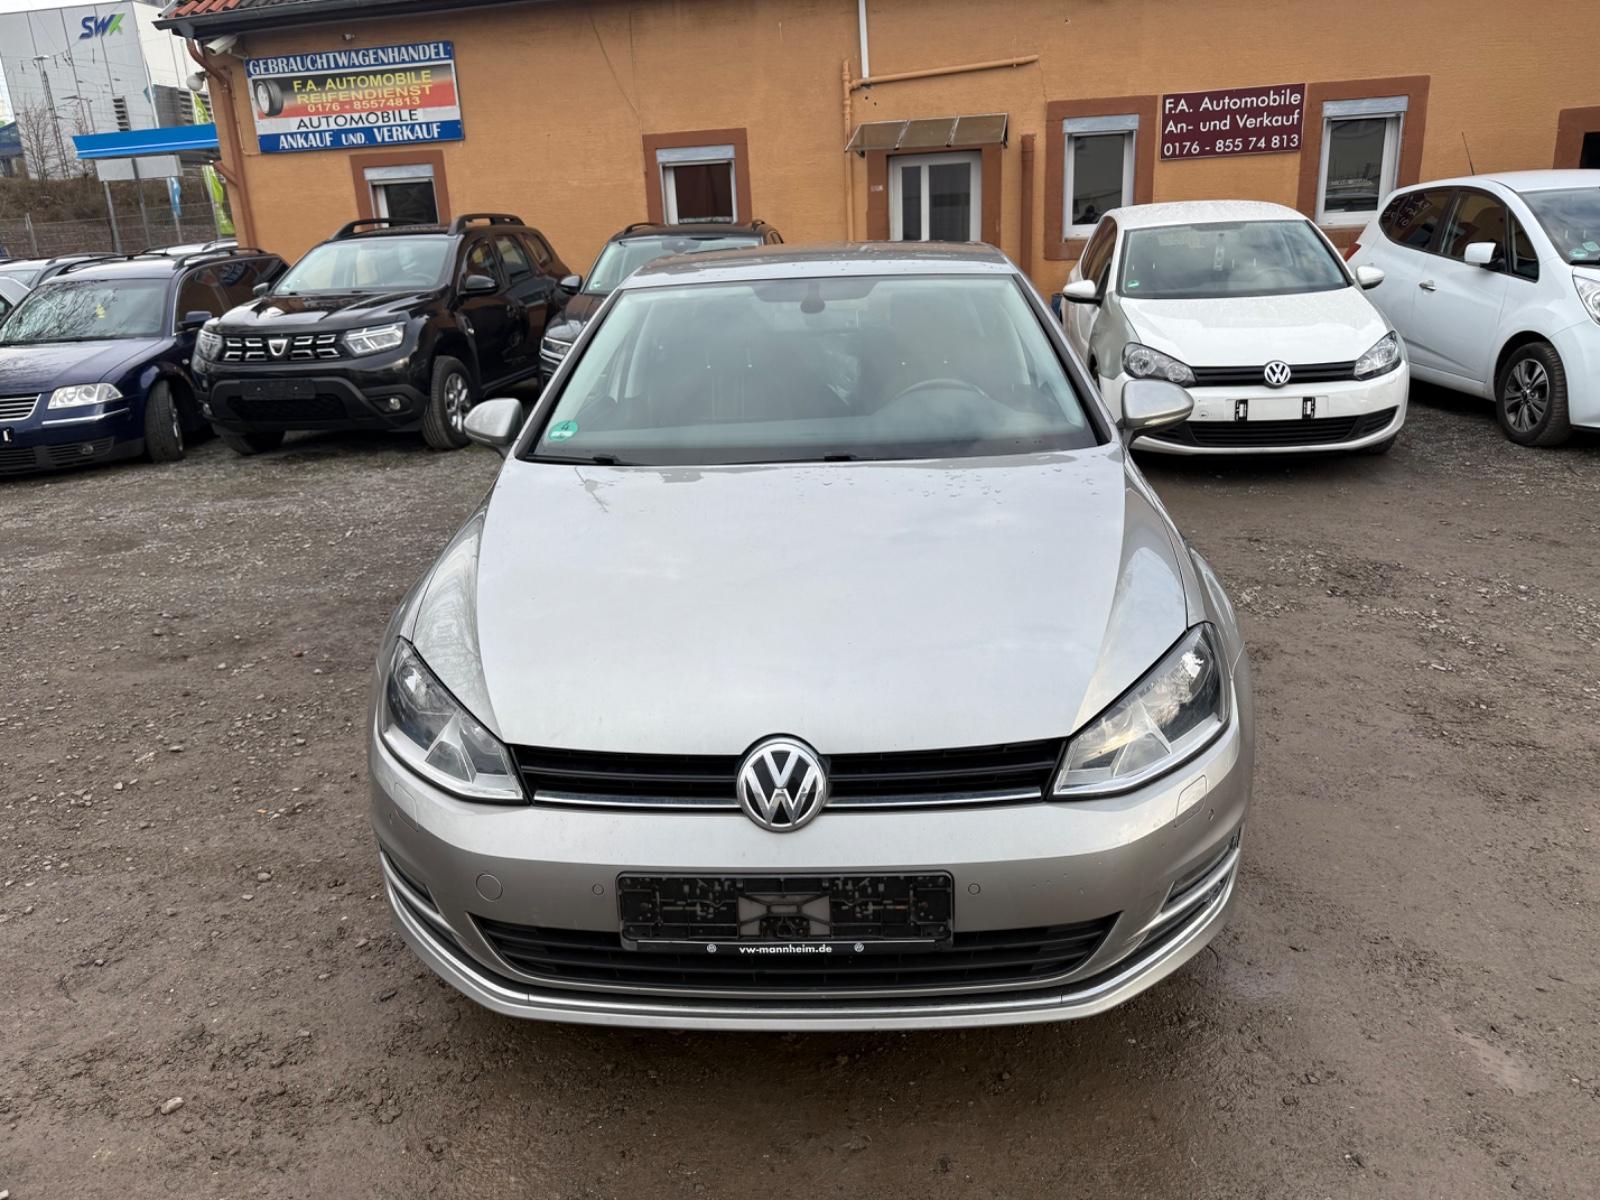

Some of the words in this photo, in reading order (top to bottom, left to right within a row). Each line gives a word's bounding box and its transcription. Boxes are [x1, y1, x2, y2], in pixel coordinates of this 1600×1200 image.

[250, 42, 449, 75] GEBRAUCHTWAGENHANDEL
[293, 80, 321, 93] F.A.
[325, 70, 433, 91] AUTOMOBILE
[296, 84, 433, 105] REIFENDIENST
[307, 102, 340, 113] 0176
[353, 96, 421, 110] 85574813
[1165, 98, 1193, 114] F.A.
[1200, 88, 1301, 111] Automobile
[297, 108, 419, 131] AUTOMOBILE
[1165, 120, 1194, 134] An-
[1200, 115, 1230, 131] und
[1236, 109, 1300, 128] Verkauf
[279, 131, 333, 150] ANKAUF
[373, 122, 441, 143] VERKAUF
[1163, 141, 1200, 156] 0176
[1215, 138, 1243, 152] 855
[1249, 137, 1266, 150] 74
[1271, 134, 1299, 148] 813
[739, 944, 833, 954] vw-mannheim.de
